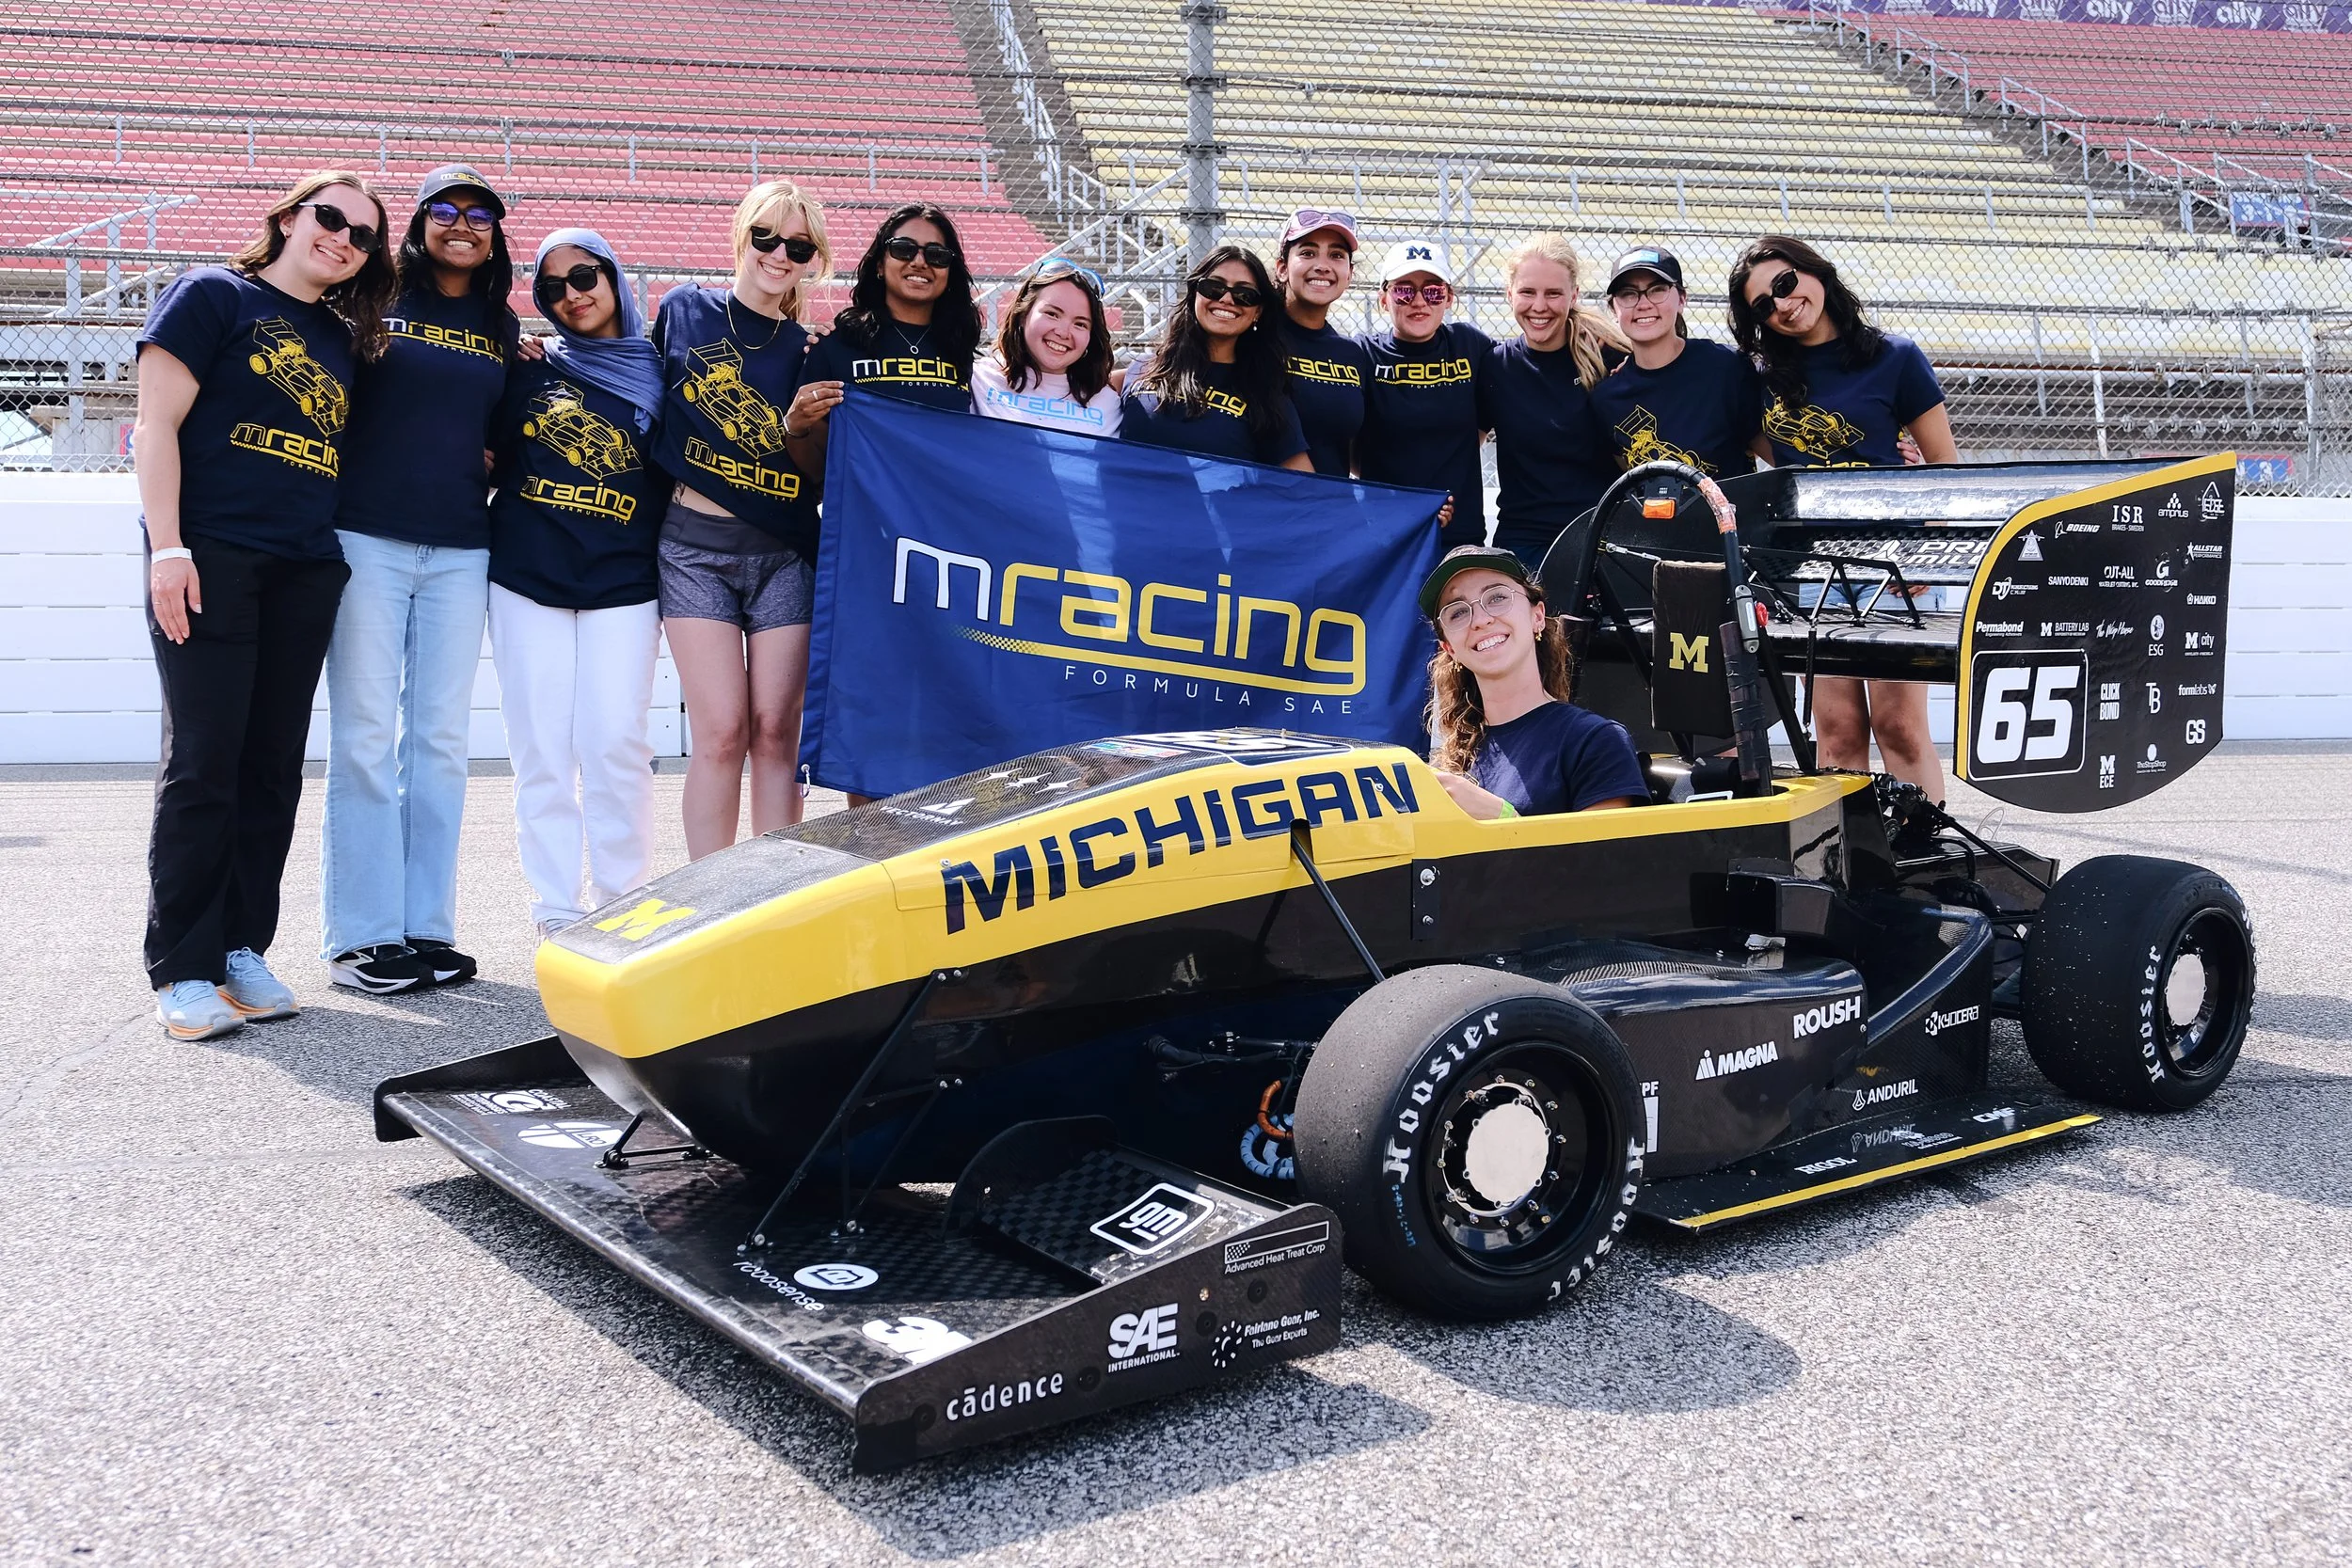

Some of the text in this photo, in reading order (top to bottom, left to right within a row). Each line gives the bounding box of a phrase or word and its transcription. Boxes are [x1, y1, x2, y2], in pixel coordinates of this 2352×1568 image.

[2217, 1, 2263, 29] ally
[1406, 245, 1432, 261] M
[852, 356, 969, 387] mracin
[1286, 357, 1360, 386] racing
[1375, 358, 1472, 385] mracing
[230, 423, 339, 473] mracin
[2066, 523, 2101, 532] BOEING
[2112, 505, 2144, 523] ISR
[893, 536, 1366, 696] mracing
[1976, 621, 2024, 632] Permabond
[2041, 622, 2052, 637] M
[2055, 622, 2077, 632] BATTERY
[2079, 622, 2090, 632] LAB
[1669, 632, 1709, 673] M
[2148, 643, 2164, 656] ESG
[2185, 632, 2215, 649] M city
[1064, 665, 1352, 715] FORMULA SAE
[2100, 683, 2121, 700] CLICK
[2178, 684, 2207, 696] formlabs
[1977, 665, 2080, 764] 65
[2099, 702, 2120, 720] BOND
[2185, 719, 2206, 744] GS
[2099, 754, 2116, 775] M
[2099, 775, 2115, 788] ECE
[943, 763, 1420, 935] MICHIGAN
[593, 898, 697, 942] M
[1793, 996, 1861, 1039] ROUSH
[1938, 1005, 1979, 1030] KYOCERA
[2139, 944, 2166, 1084] Hoosier
[1717, 1040, 1778, 1076] MAGNA
[1384, 1011, 1500, 1184] Hoosier
[1640, 1081, 1660, 1097] PF
[1867, 1079, 1918, 1104] ANDURIL
[1794, 1156, 1857, 1175] RIGOL
[1119, 1201, 1188, 1237] gm
[1224, 1243, 1327, 1275] Advanced Heat Treat Corp
[1108, 1303, 1179, 1359] SAE
